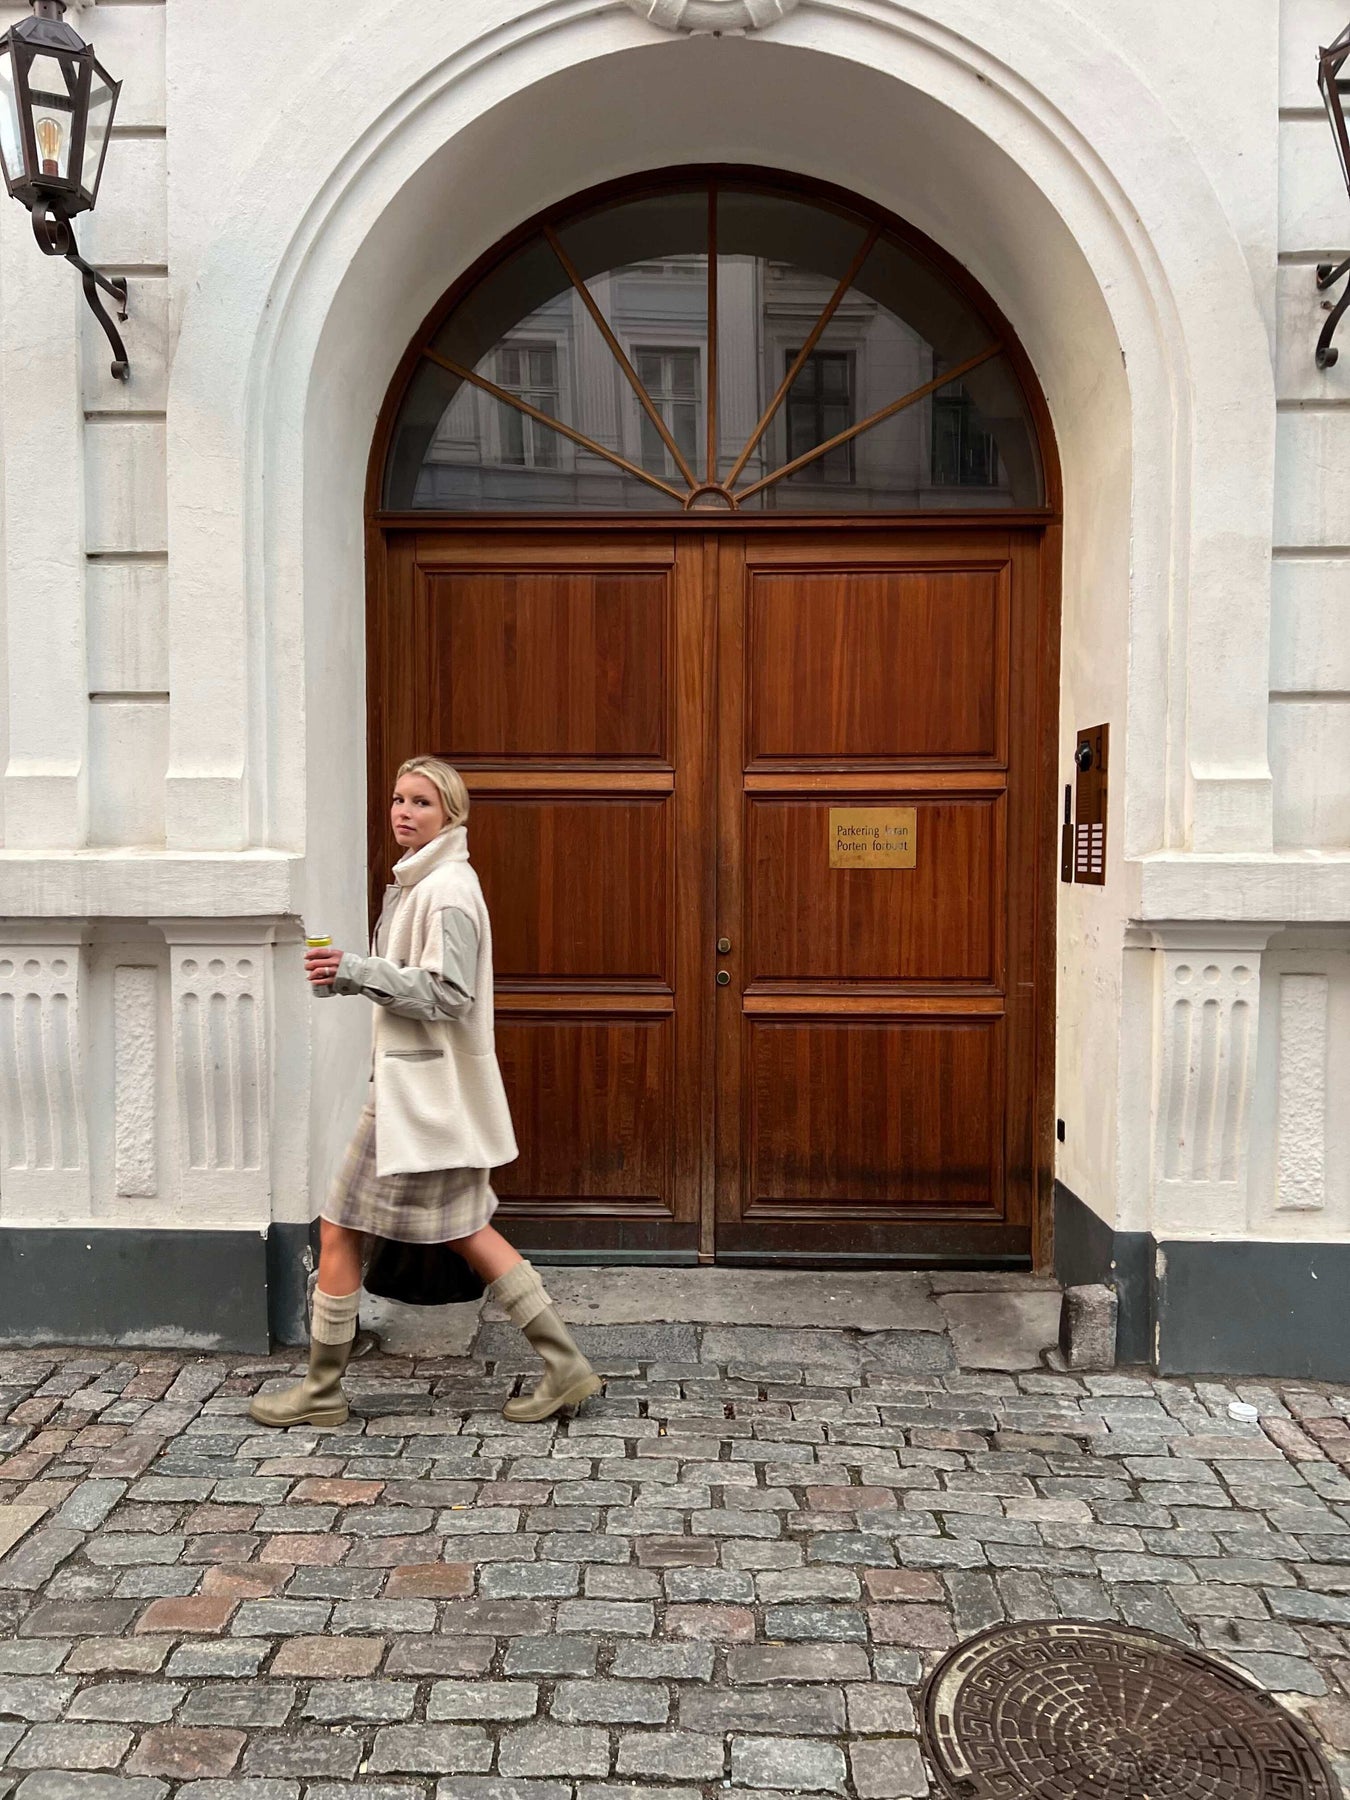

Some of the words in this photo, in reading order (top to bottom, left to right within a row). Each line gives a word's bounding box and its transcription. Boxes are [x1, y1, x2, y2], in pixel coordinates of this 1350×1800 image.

[837, 825, 880, 839] Parkering
[884, 825, 909, 836] ran
[837, 839, 867, 851] Porten
[872, 839, 909, 851] fobt
